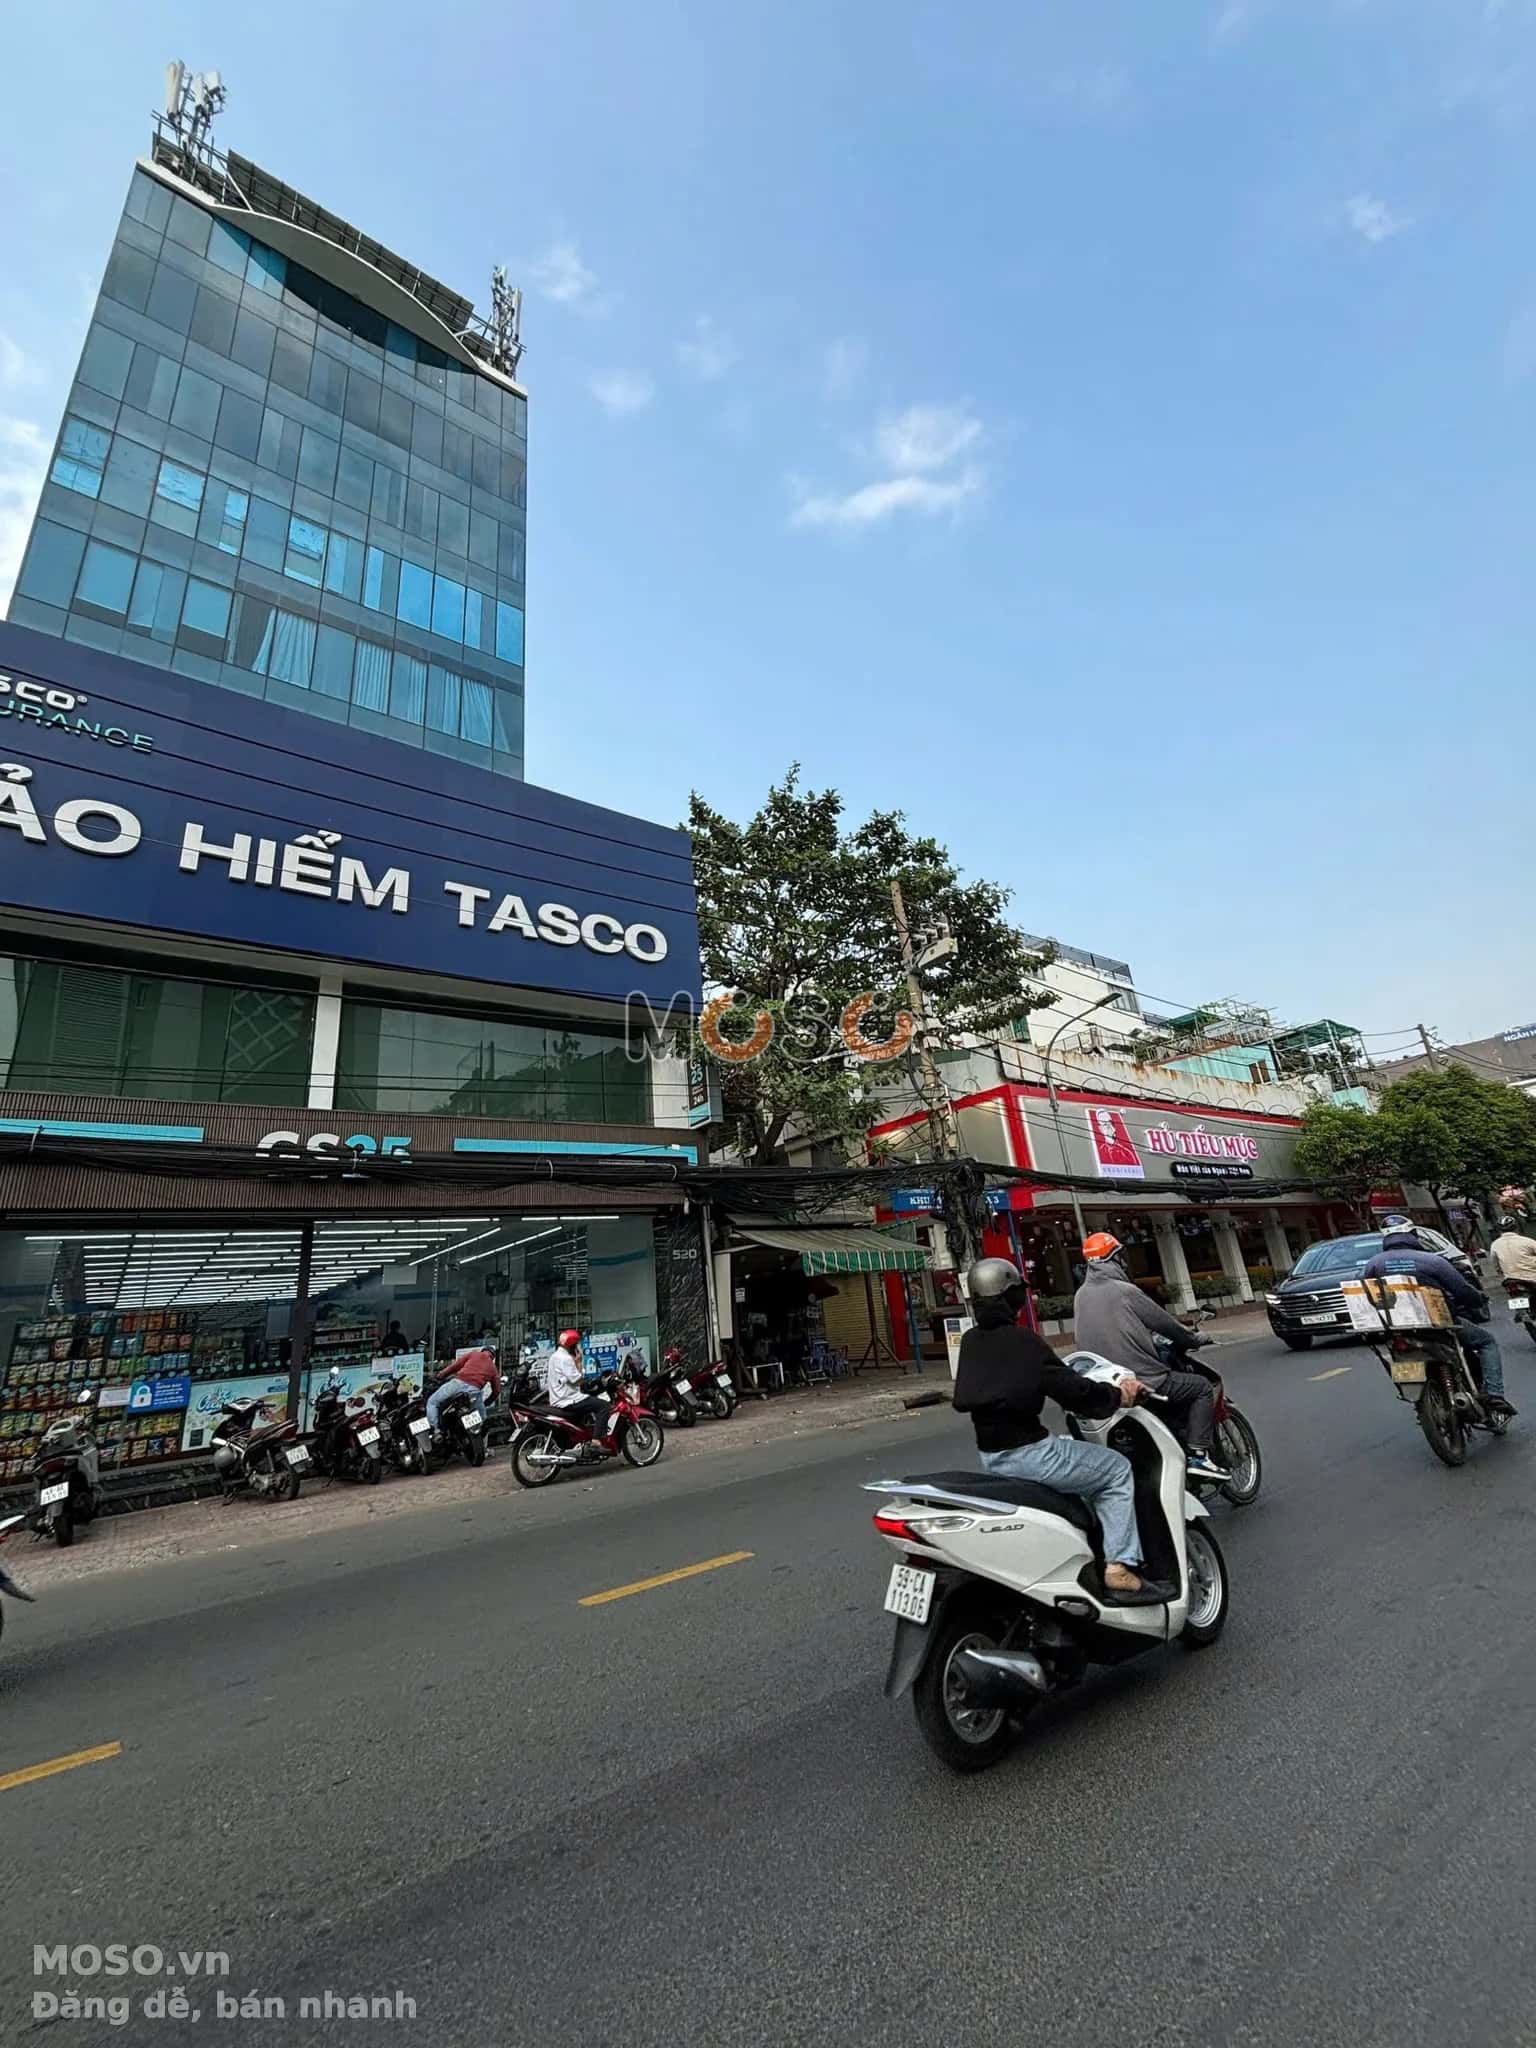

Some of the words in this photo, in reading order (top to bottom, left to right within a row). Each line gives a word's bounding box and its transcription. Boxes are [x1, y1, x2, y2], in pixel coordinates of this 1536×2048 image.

[179, 822, 410, 913] HIỂM
[444, 880, 668, 963] TASCO
[690, 1069, 703, 1084] 25
[1145, 1121, 1177, 1153] HỦ
[1177, 1124, 1220, 1156] TIẾU
[672, 1248, 697, 1260] 520
[979, 1524, 1025, 1534] LEAD
